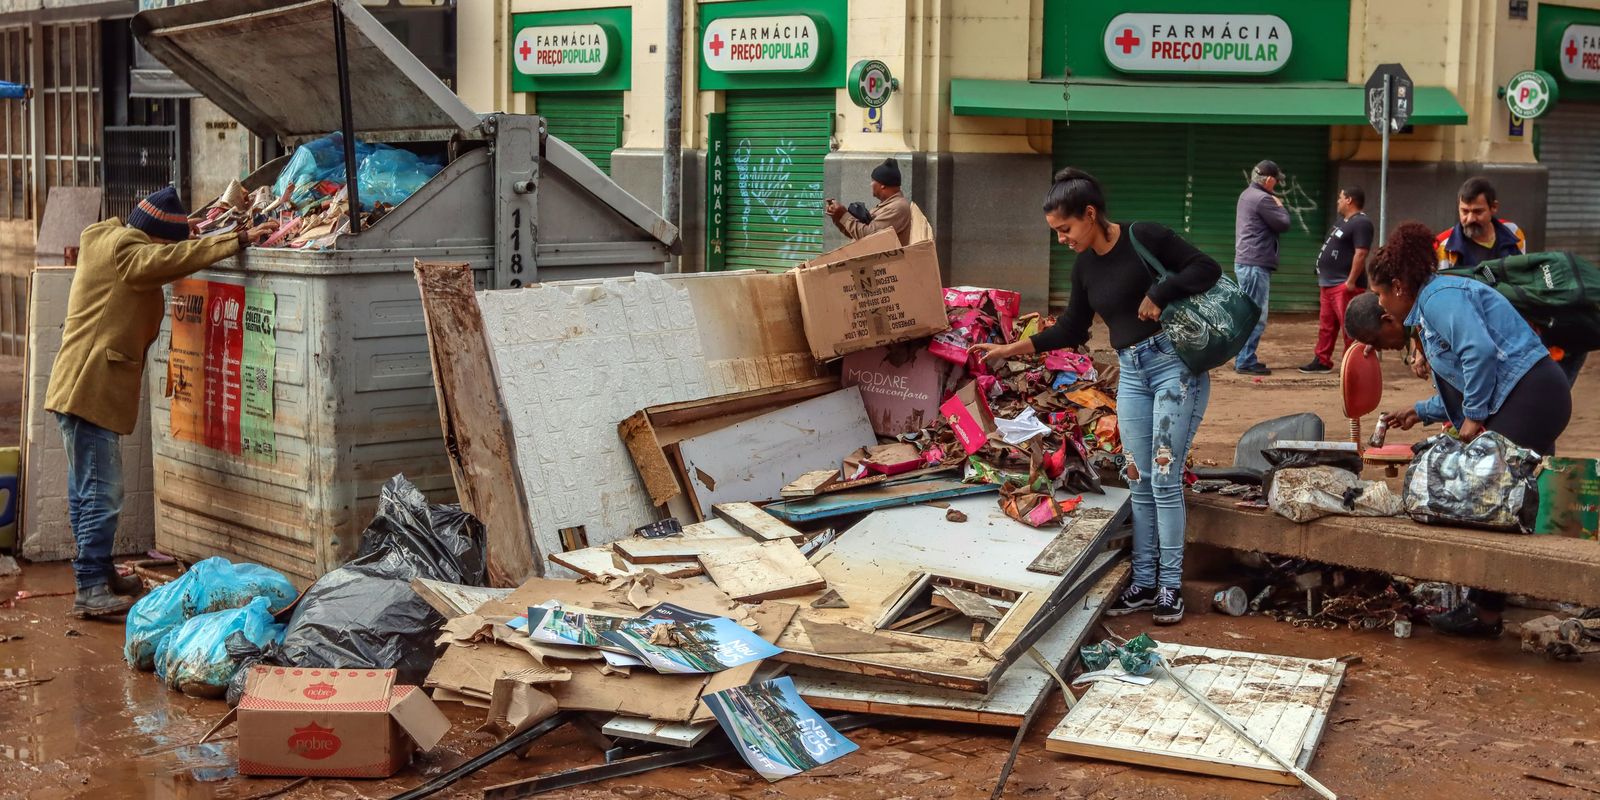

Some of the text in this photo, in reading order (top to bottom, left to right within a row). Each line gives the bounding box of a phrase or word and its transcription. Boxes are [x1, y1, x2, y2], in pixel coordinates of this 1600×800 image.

[536, 26, 601, 46] FARMÁCIA
[731, 22, 809, 41] FARMÁCIA
[1152, 22, 1279, 40] FARMÁCIA
[1583, 35, 1600, 49] FA
[536, 47, 601, 66] PREÇOPOPULAR
[731, 42, 809, 63] PREÇOPOPULAR
[1151, 42, 1278, 62] PREÇOPOPULAR
[869, 77, 883, 93] PP
[1519, 87, 1538, 104] PP
[713, 140, 722, 254] FARMÁCIA
[186, 294, 204, 314] LIXO
[224, 297, 240, 320] NÃO
[891, 318, 916, 330] EXPRESSO
[848, 368, 909, 389] MODARE
[307, 687, 333, 696] nobre
[296, 736, 333, 751] nobre
